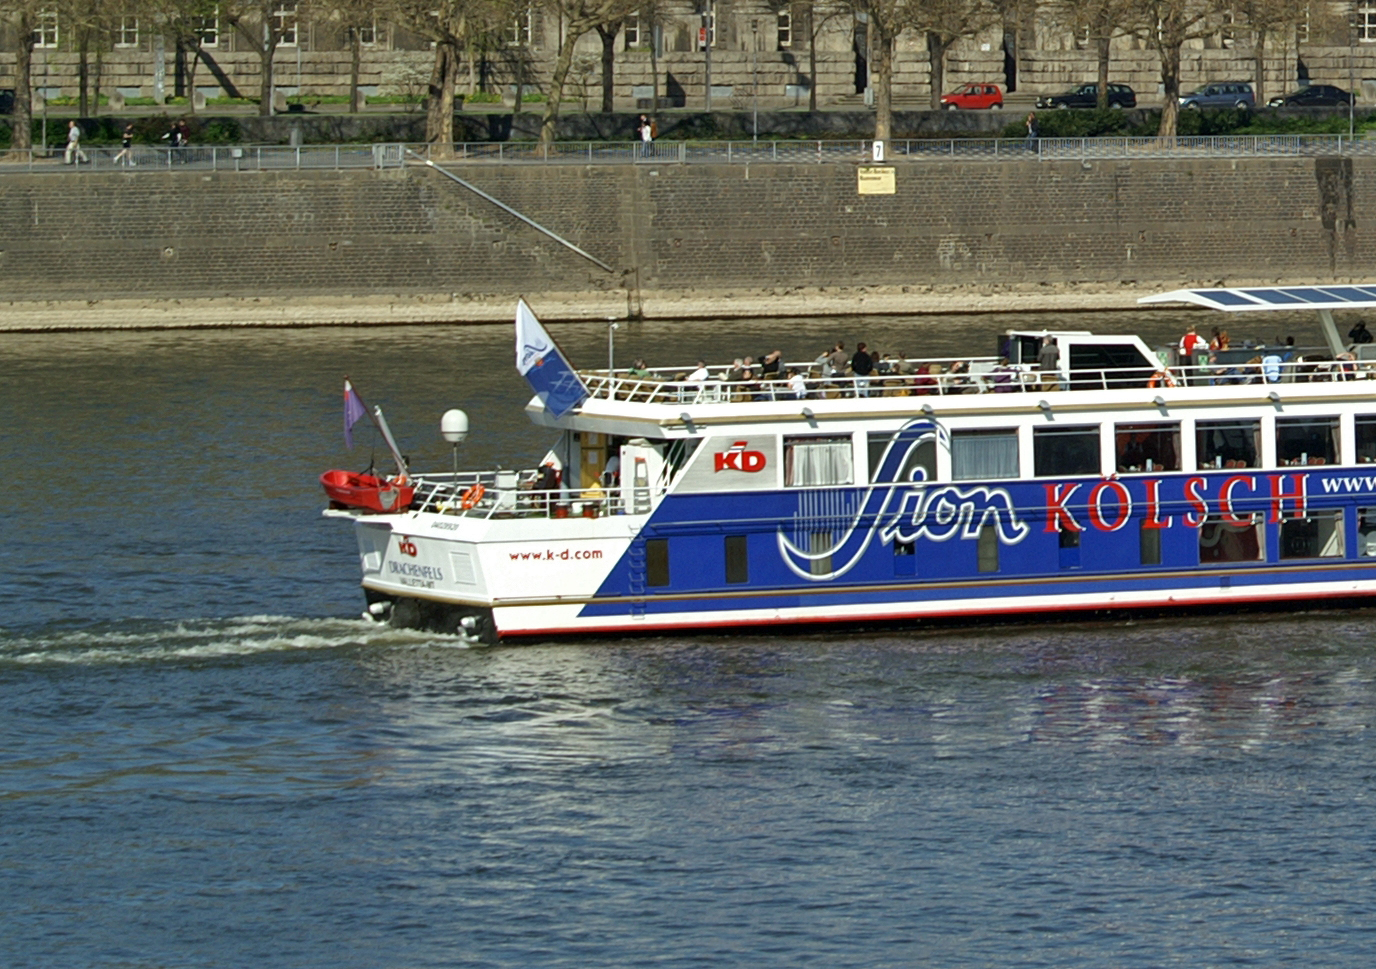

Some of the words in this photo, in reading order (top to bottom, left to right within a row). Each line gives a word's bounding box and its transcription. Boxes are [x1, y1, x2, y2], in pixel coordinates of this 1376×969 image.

[714, 450, 767, 474] KD
[777, 416, 1030, 581] Sion
[1042, 472, 1311, 533] KÖLSCH
[509, 549, 603, 561] www.k-d.com
[388, 560, 444, 581] DRACHENFELS
